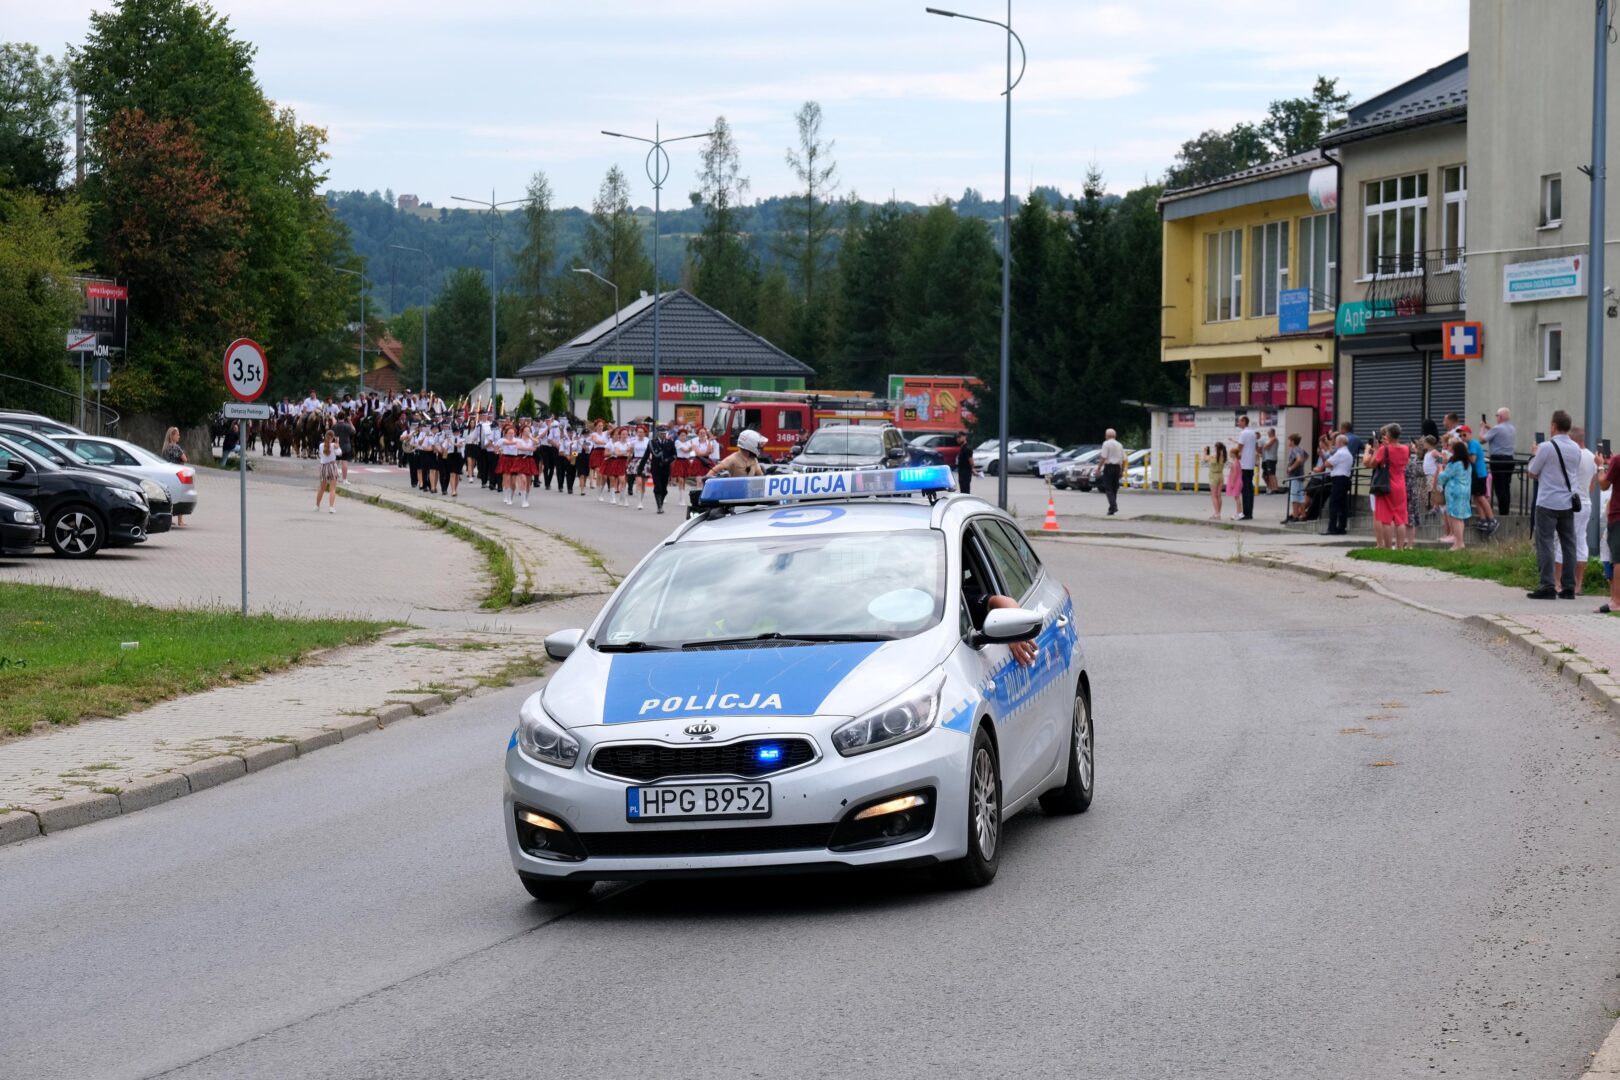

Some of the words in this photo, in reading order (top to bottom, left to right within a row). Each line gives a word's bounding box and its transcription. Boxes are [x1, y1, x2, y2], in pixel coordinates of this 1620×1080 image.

[233, 358, 261, 385] 3,5t
[662, 379, 722, 397] Delikatesy
[768, 474, 846, 496] POLICJA
[638, 693, 783, 715] POLICJA
[688, 724, 713, 733] KIA
[643, 789, 696, 814] HPG
[704, 787, 766, 812] B952
